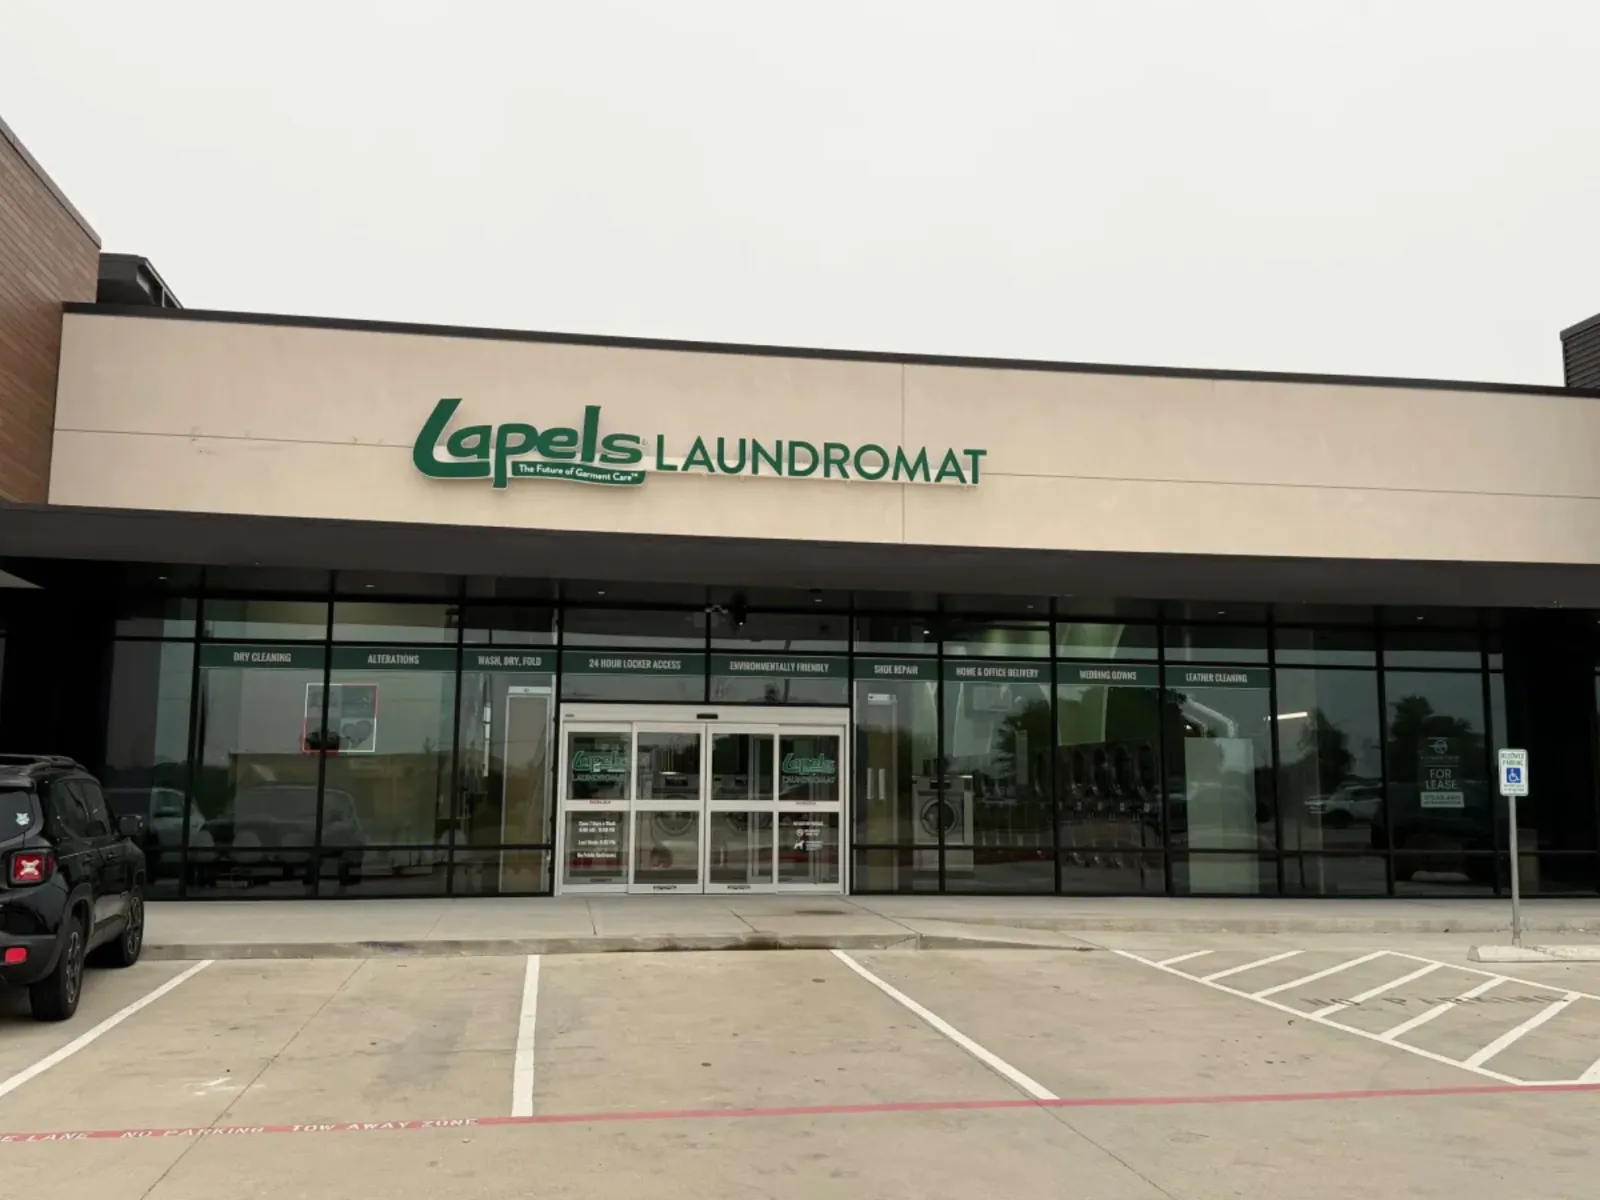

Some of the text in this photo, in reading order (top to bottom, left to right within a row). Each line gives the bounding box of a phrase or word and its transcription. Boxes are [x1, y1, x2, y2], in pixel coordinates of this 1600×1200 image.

[412, 398, 644, 488] Lapels
[656, 434, 988, 485] LAUNDROMAT
[519, 464, 534, 473] The
[536, 464, 563, 475] Future
[564, 467, 575, 475] of
[575, 468, 611, 481] Garment
[233, 652, 292, 662] DRY CLEANING
[367, 654, 420, 664] ALTERATIONS
[522, 656, 542, 666] FOLD
[588, 658, 682, 670] 24 HOUR LOCKER ACCESS
[729, 661, 829, 672] ENVIRONMENTALLY FRIENDLY
[874, 665, 919, 675] SHOE REPAIR
[955, 667, 1040, 678] HOME & OFFICE DELIVERY
[1111, 671, 1137, 680] GOWNS
[1185, 673, 1249, 683] LEATHER CLEANING
[1429, 768, 1452, 779] FOR
[1425, 780, 1457, 790] LEASE
[27, 1132, 88, 1142] LANE
[120, 1130, 152, 1138] NO
[163, 1127, 265, 1137] PARKING
[293, 1124, 336, 1132] TOW
[346, 1121, 409, 1130] AWAY
[421, 1118, 478, 1128] ZONE
